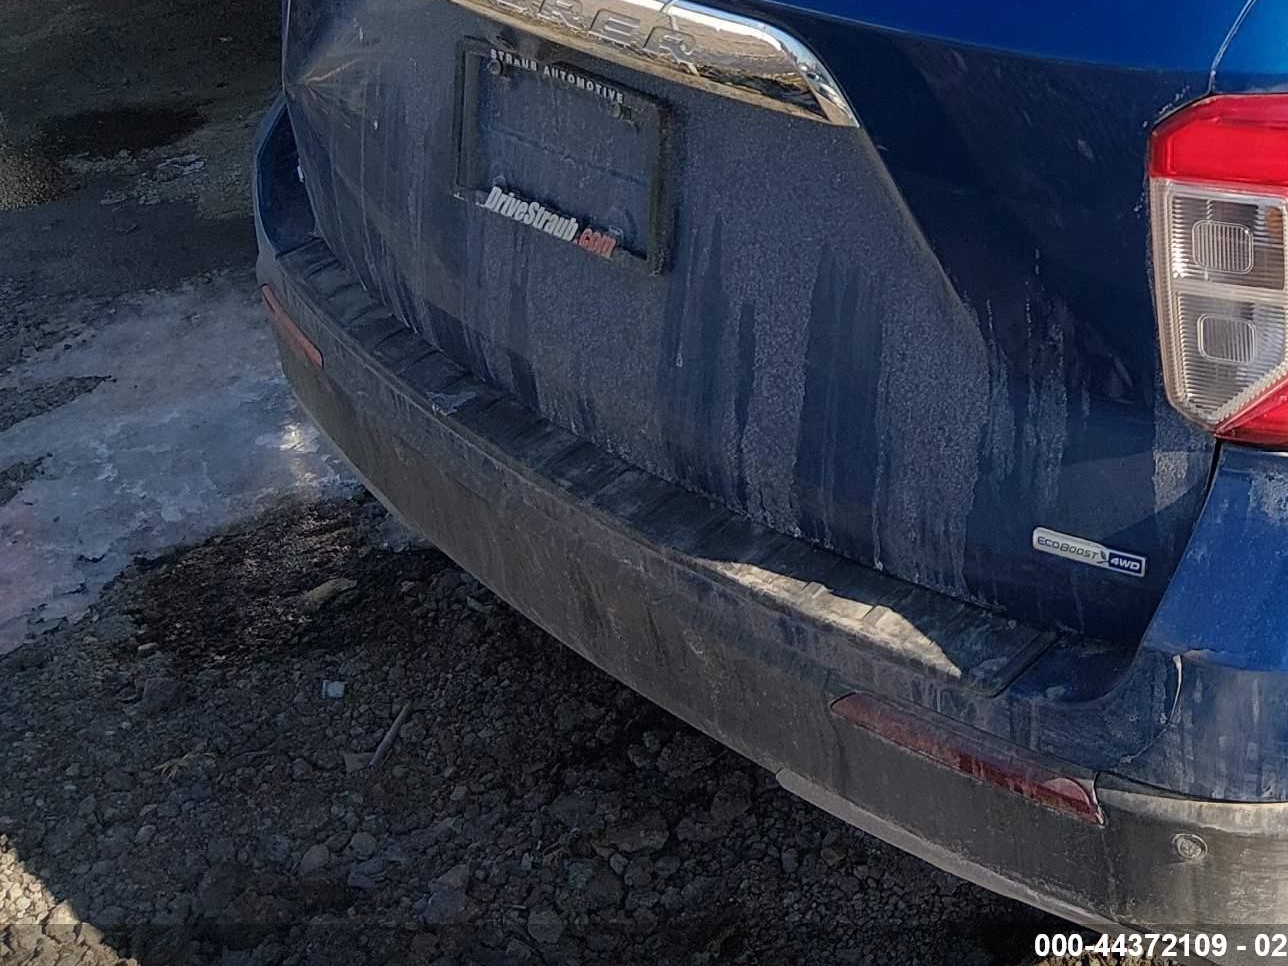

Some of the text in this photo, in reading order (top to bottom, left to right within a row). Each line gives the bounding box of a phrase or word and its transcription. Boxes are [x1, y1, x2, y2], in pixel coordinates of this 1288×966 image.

[490, 48, 624, 104] STRAUB AUTOMOTIVE
[1110, 557, 1141, 571] 4WD
